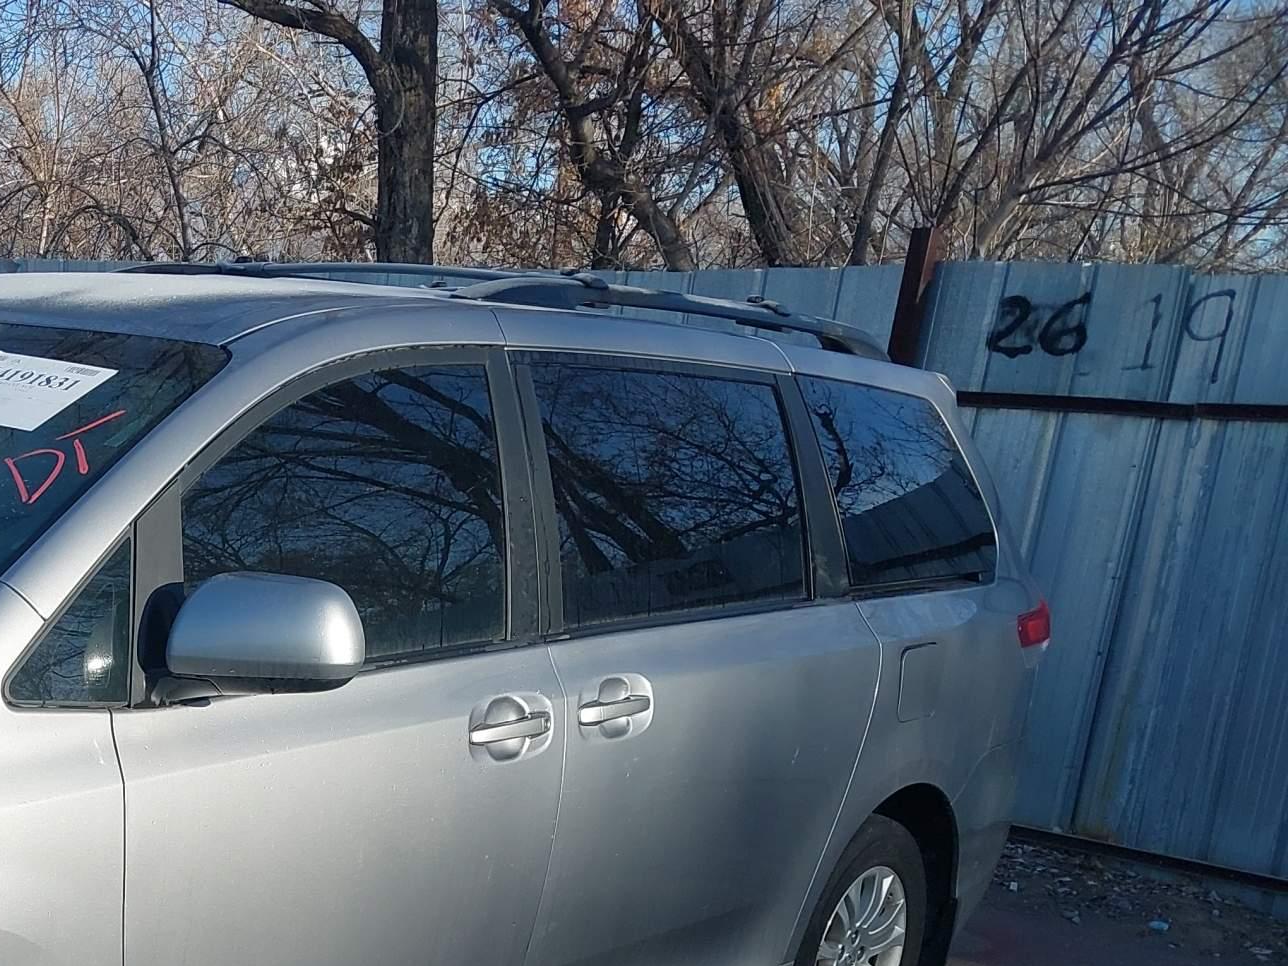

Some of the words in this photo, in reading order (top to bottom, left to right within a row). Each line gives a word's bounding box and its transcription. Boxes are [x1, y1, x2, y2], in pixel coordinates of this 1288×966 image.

[986, 291, 1091, 358] 26
[1120, 288, 1236, 384] 19
[3, 409, 128, 504] DT
